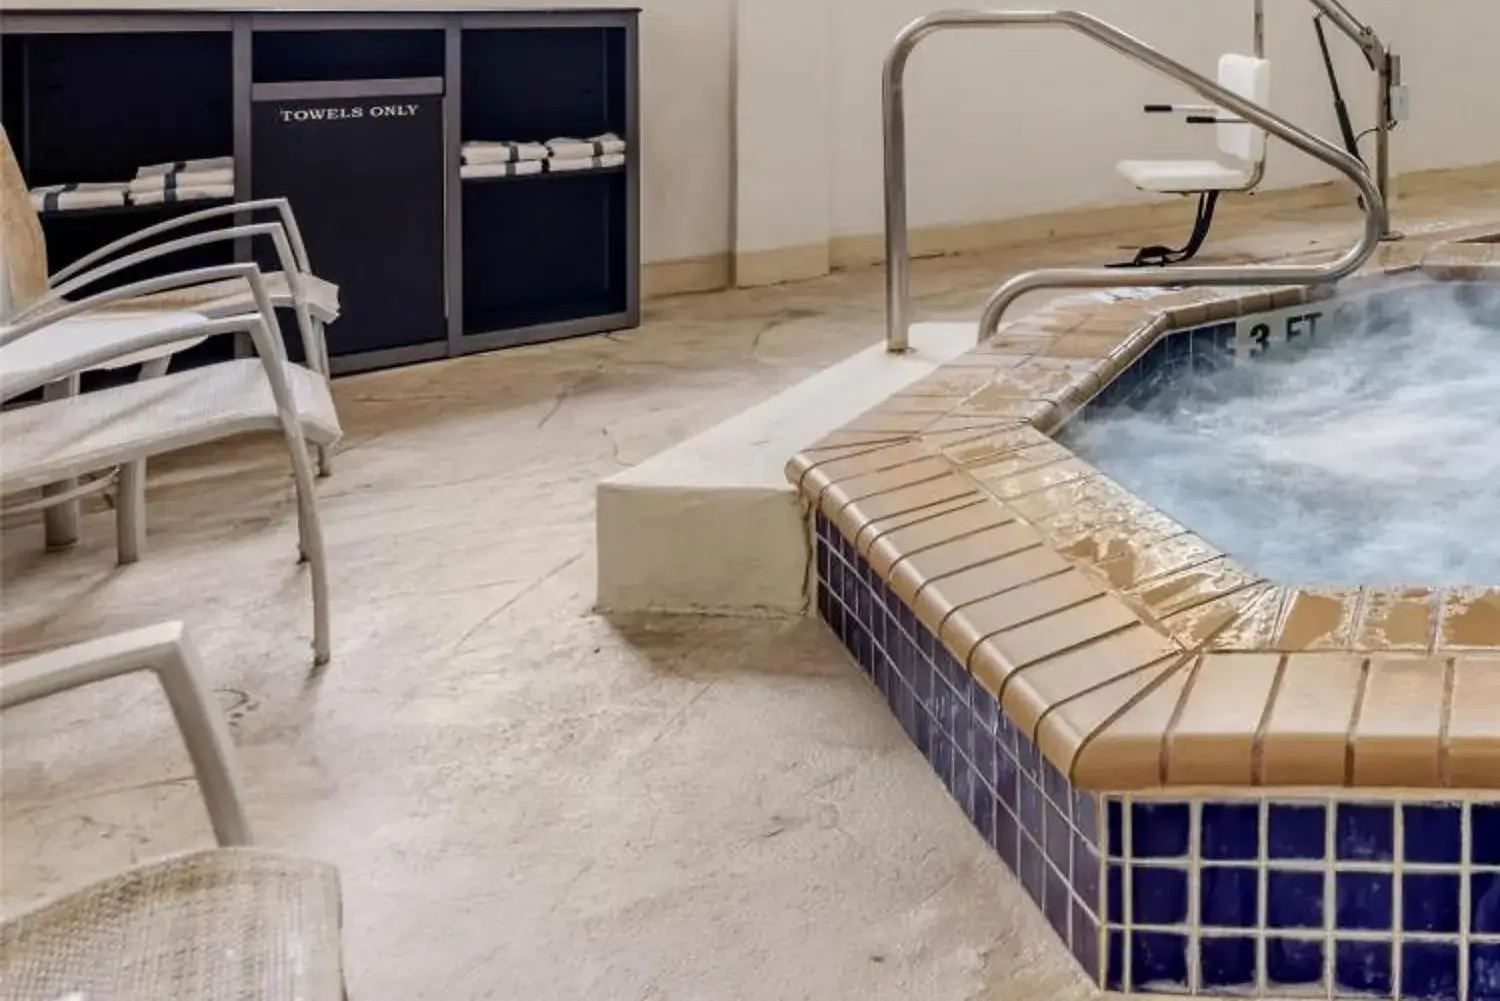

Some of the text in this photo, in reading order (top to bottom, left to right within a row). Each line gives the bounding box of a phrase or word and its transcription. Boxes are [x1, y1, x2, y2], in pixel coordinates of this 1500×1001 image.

[280, 104, 419, 122] TOWELS ONLY
[1249, 311, 1323, 358] 3 FT
